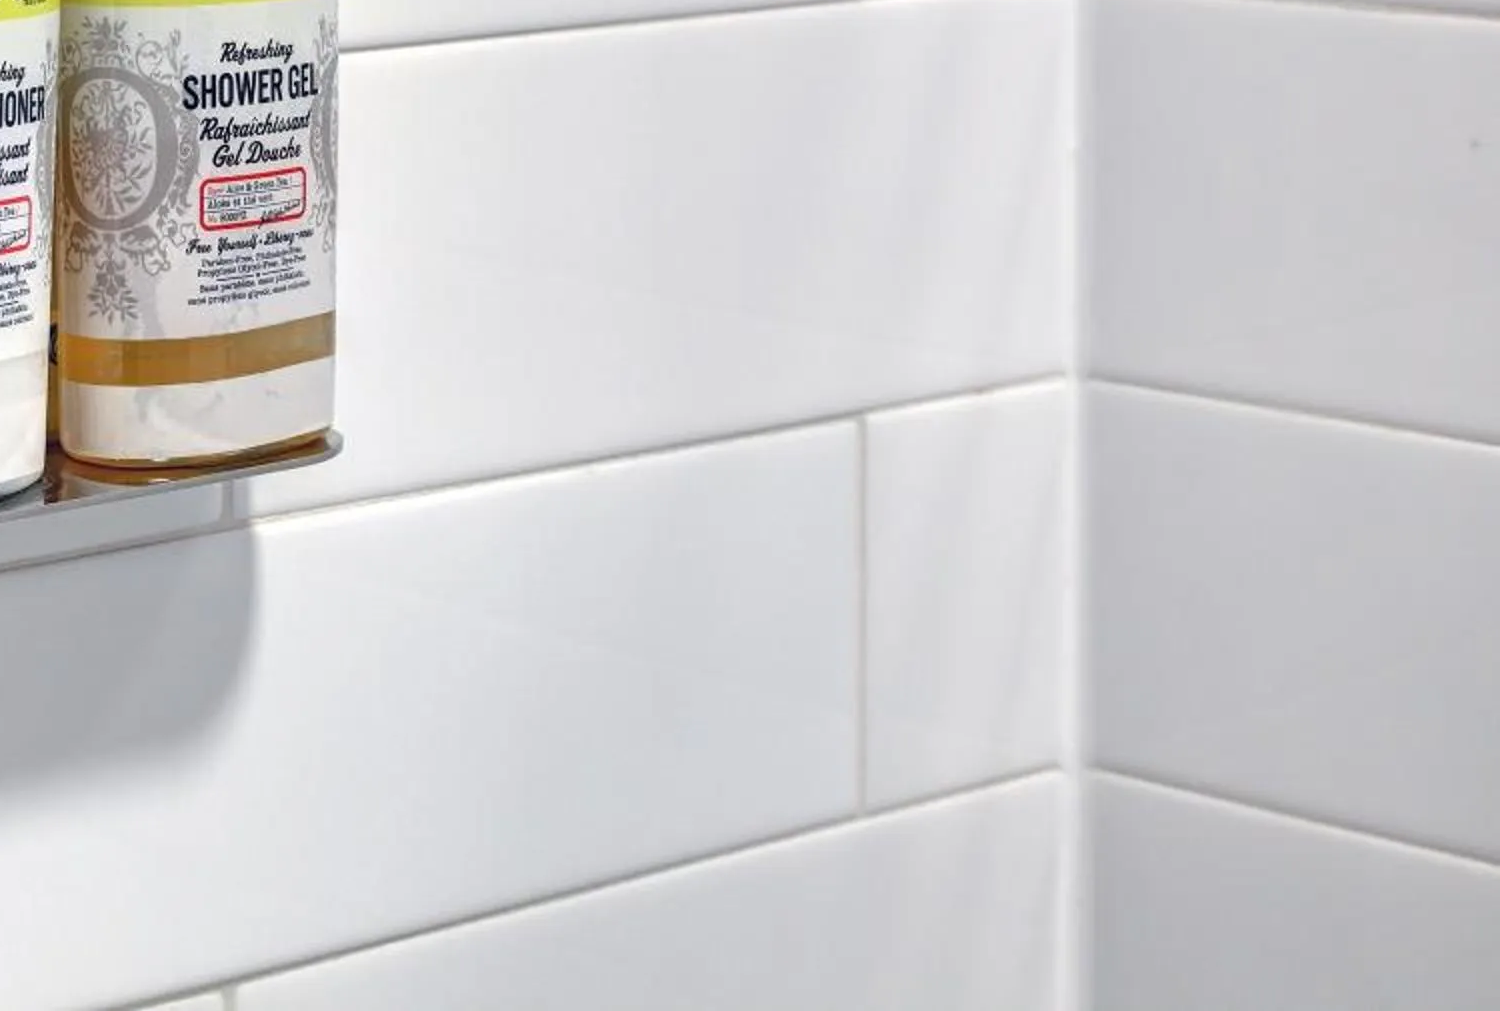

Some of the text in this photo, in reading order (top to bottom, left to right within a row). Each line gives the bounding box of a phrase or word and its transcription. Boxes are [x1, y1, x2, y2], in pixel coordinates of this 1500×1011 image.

[220, 39, 294, 66] Refreshing
[182, 62, 318, 111] SHOWER GEL
[200, 109, 311, 143] Rafraîchissant
[213, 137, 301, 168] Gel Douche
